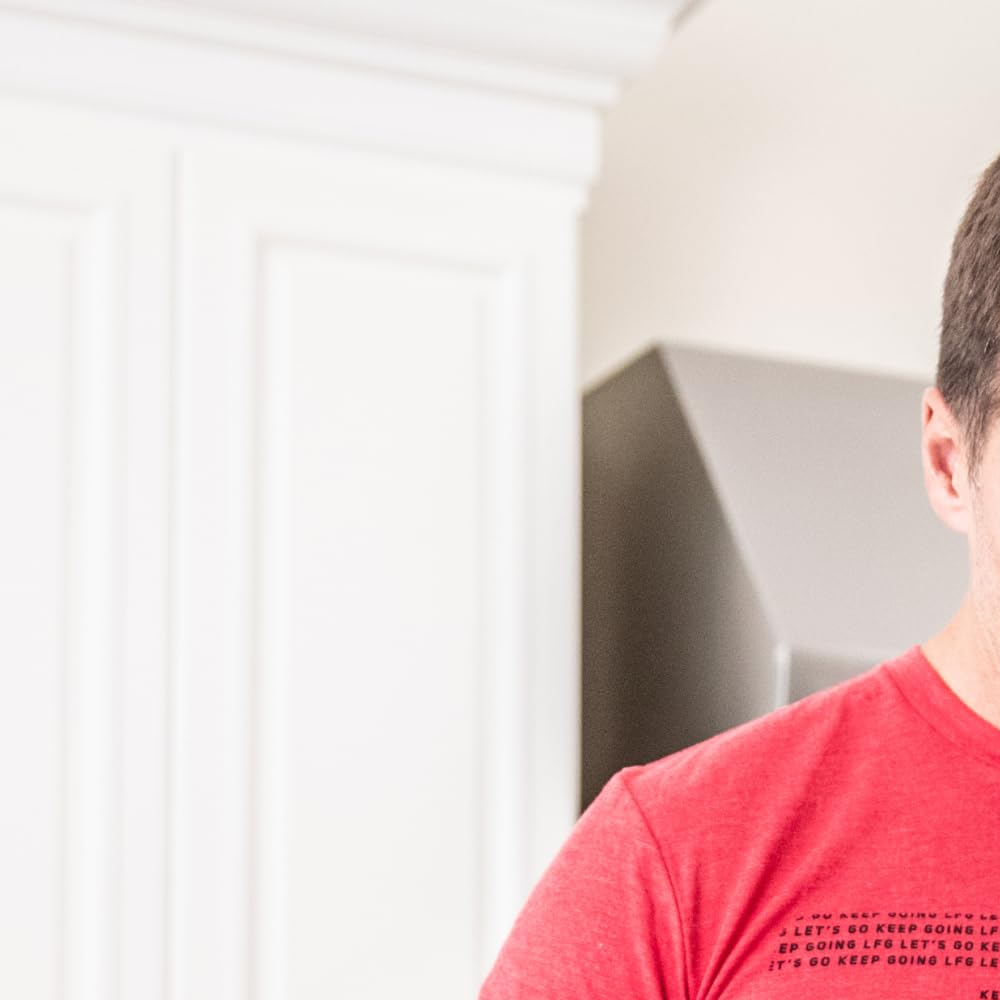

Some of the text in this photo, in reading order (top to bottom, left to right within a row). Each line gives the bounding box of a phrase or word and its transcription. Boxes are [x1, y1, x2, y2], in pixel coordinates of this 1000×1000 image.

[794, 925, 841, 937] LET'S
[847, 923, 869, 934] GO
[875, 923, 918, 934] KEEP
[923, 923, 974, 936] GOING
[805, 939, 856, 952] GOING
[863, 938, 894, 950] LFG
[900, 939, 946, 951] LET'S
[953, 940, 974, 952] GO
[809, 956, 831, 967] GO
[837, 954, 881, 966] KEEP
[887, 954, 937, 966] GOING
[944, 955, 974, 967] LFG
